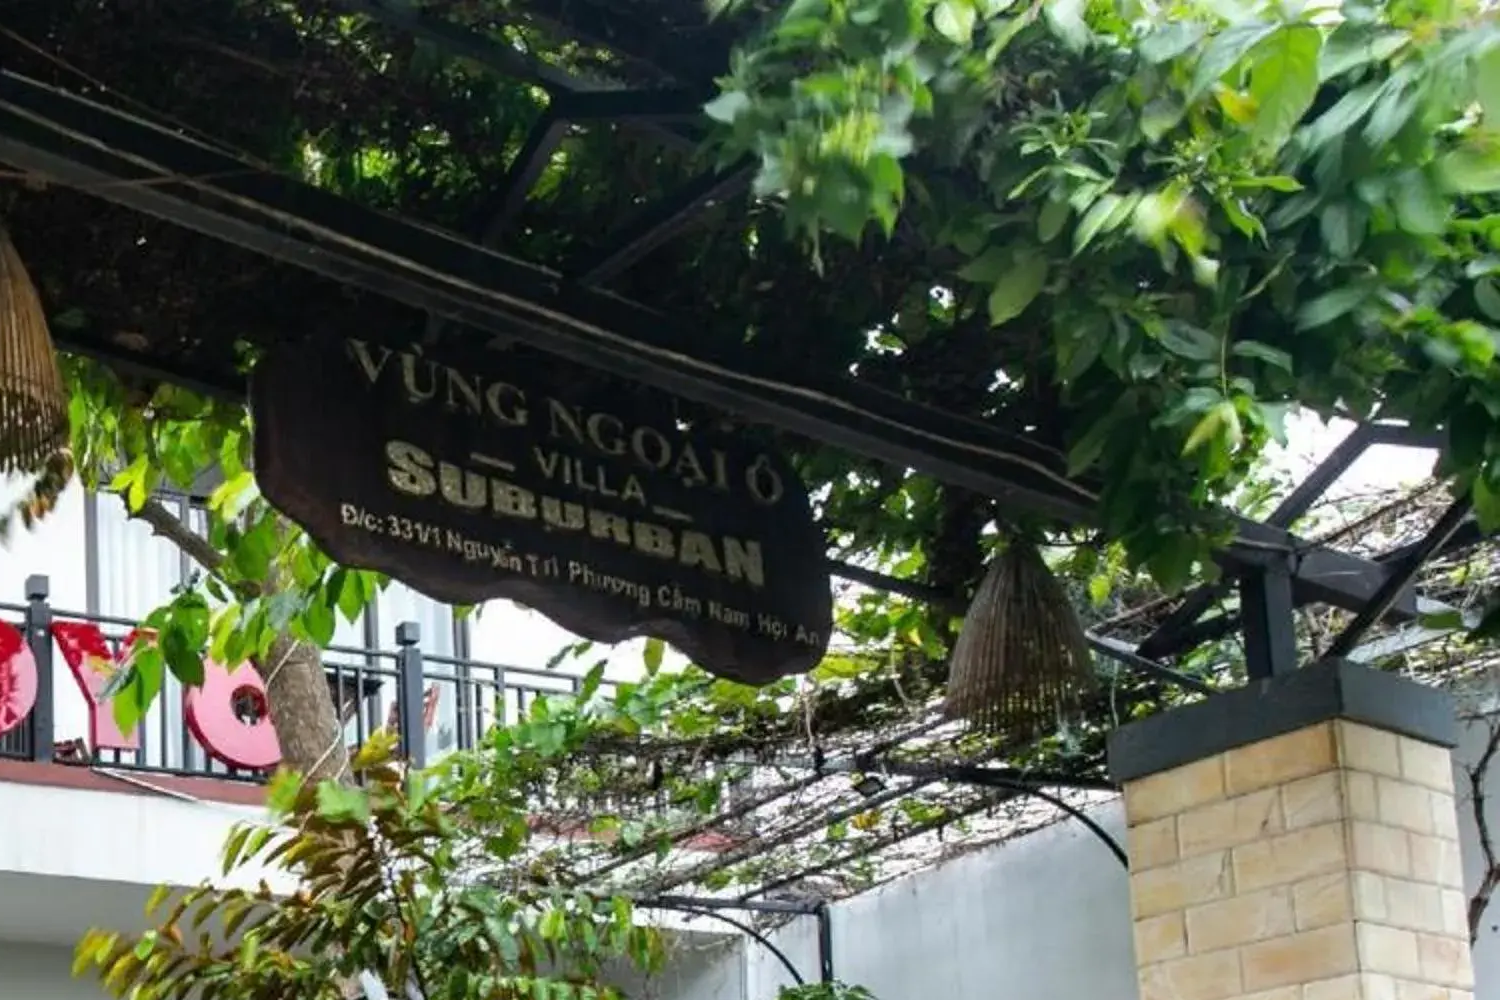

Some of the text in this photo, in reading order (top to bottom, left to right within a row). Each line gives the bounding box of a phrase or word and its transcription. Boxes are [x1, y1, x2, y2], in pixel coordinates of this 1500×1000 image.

[534, 445, 646, 507] VILLA
[547, 397, 730, 494] NGOẠI
[746, 453, 785, 504] Ô
[385, 438, 764, 586] SUBURBAN
[708, 601, 750, 629] Nam
[795, 624, 820, 646] An
